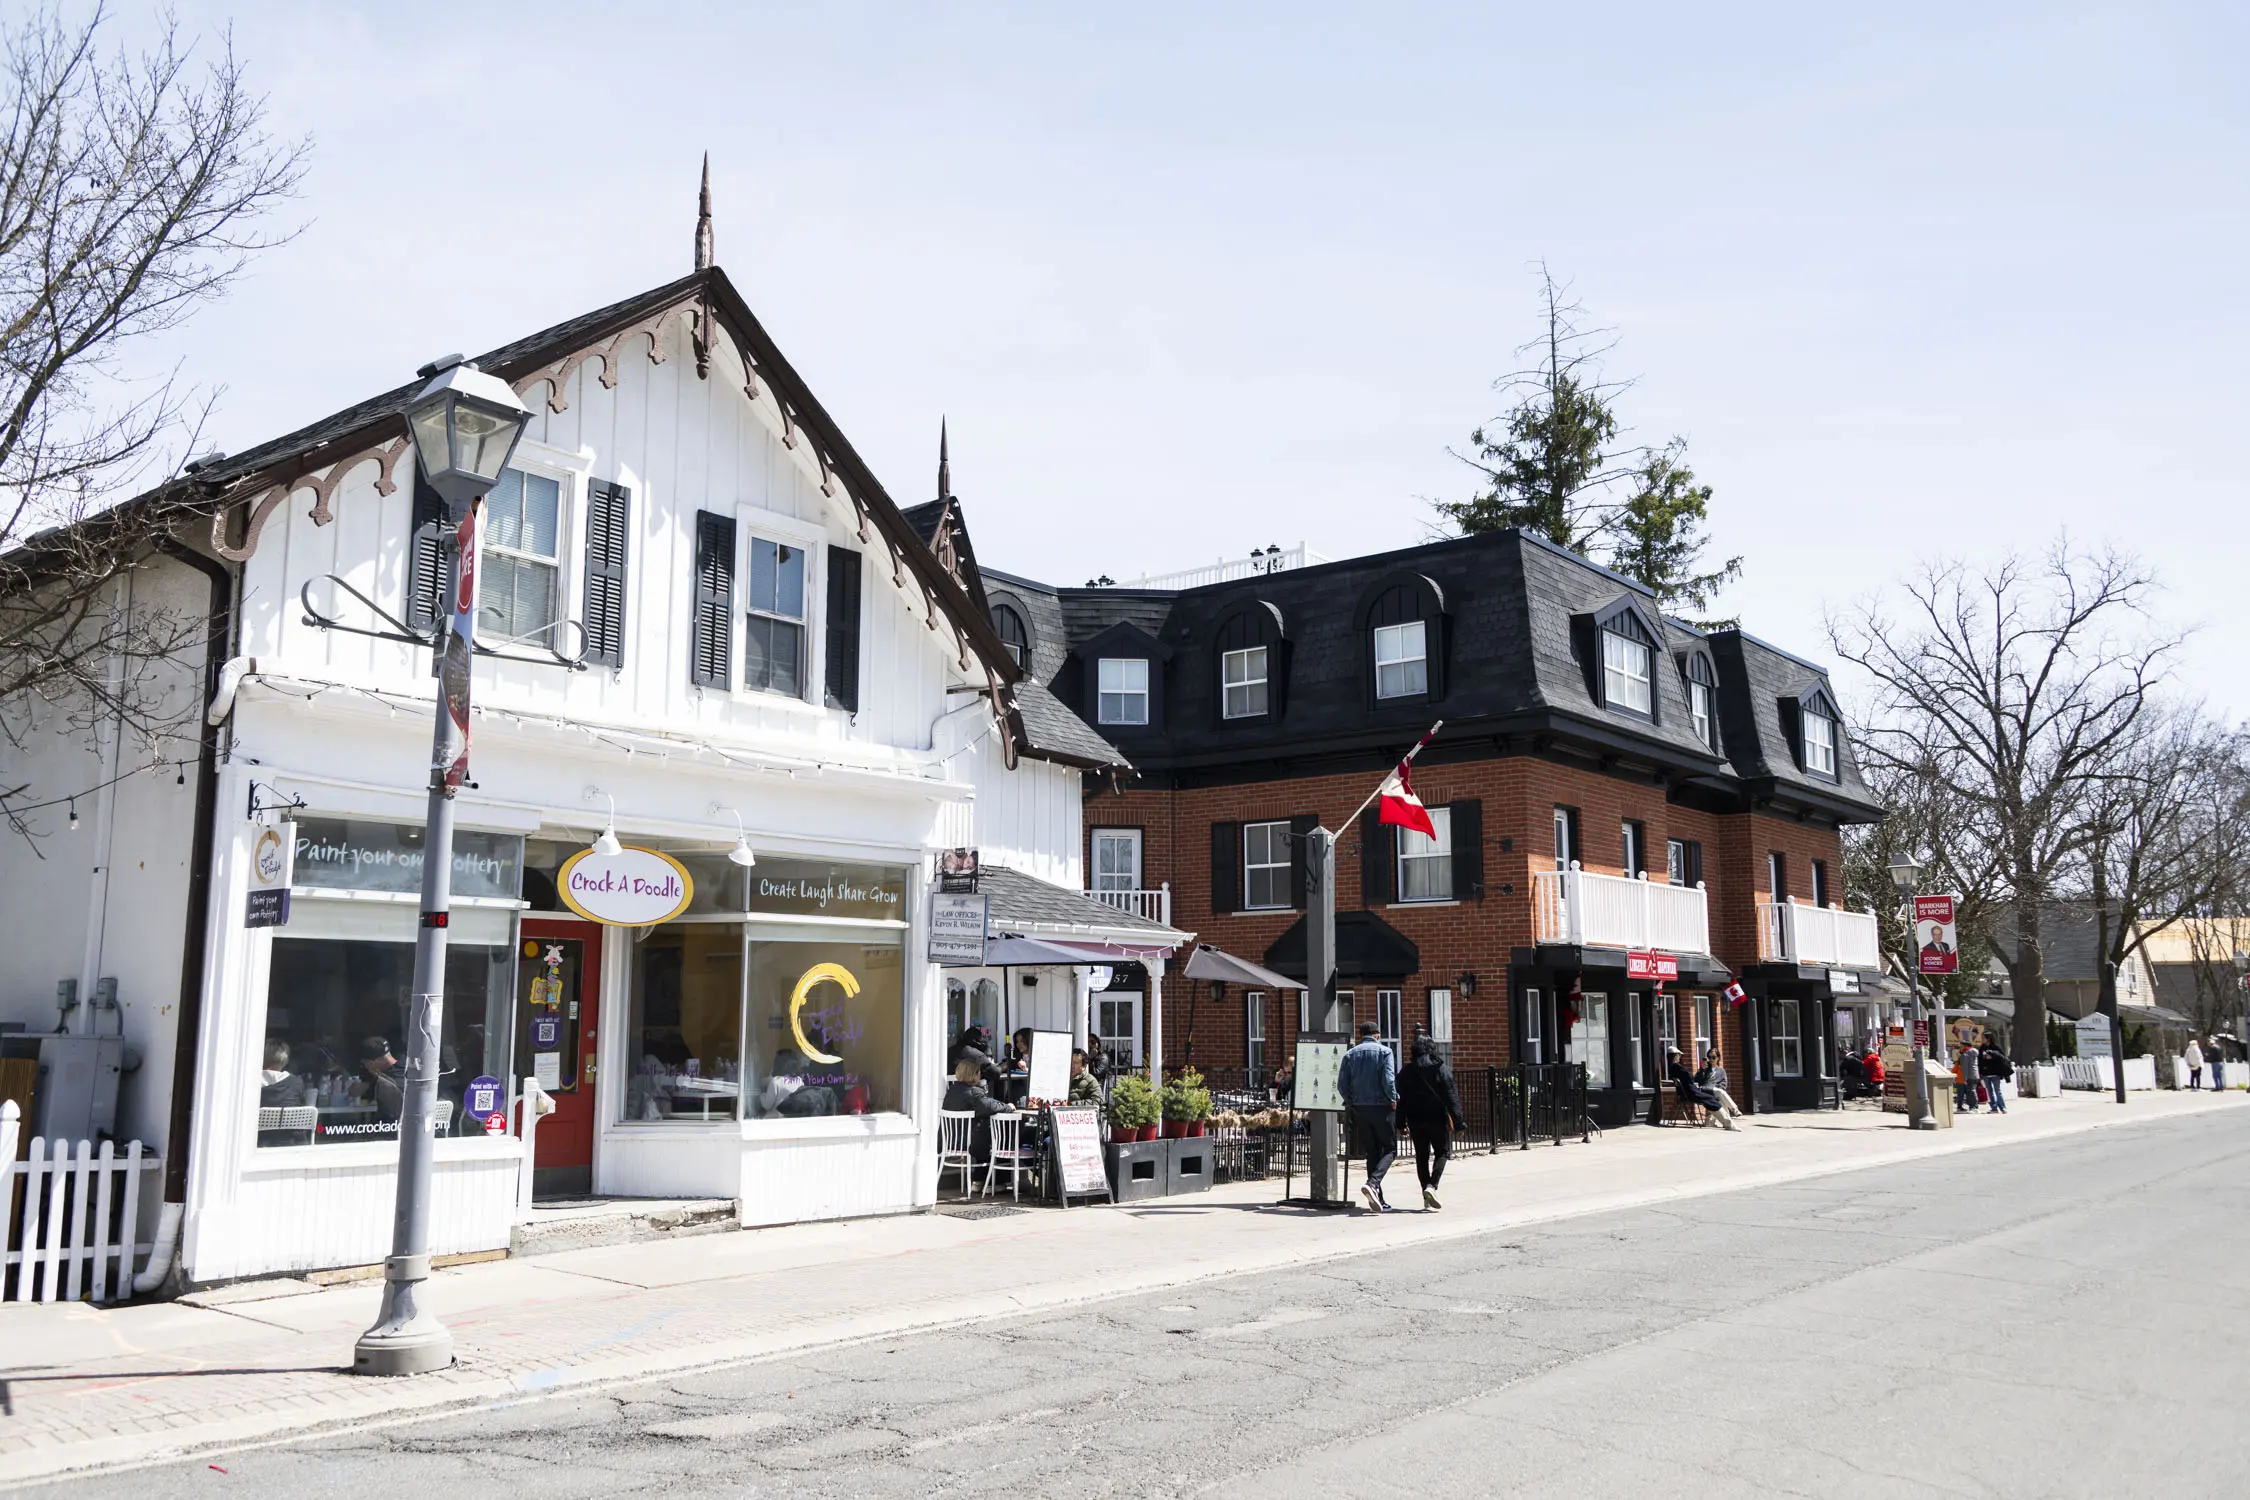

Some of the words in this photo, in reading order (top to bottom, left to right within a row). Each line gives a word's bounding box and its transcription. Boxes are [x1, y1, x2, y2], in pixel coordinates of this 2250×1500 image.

[294, 837, 347, 864] Paint
[352, 848, 392, 874] your
[399, 852, 424, 868] ow
[451, 851, 504, 884] ottery
[572, 870, 614, 893] Crock
[618, 875, 628, 893] A
[633, 875, 681, 898] Doodle
[760, 878, 797, 899] Create
[800, 876, 834, 908] Laugh
[837, 877, 867, 901] Share
[870, 886, 899, 903] Grow
[955, 911, 977, 919] OFFICES
[1058, 1113, 1095, 1125] MASSAGE
